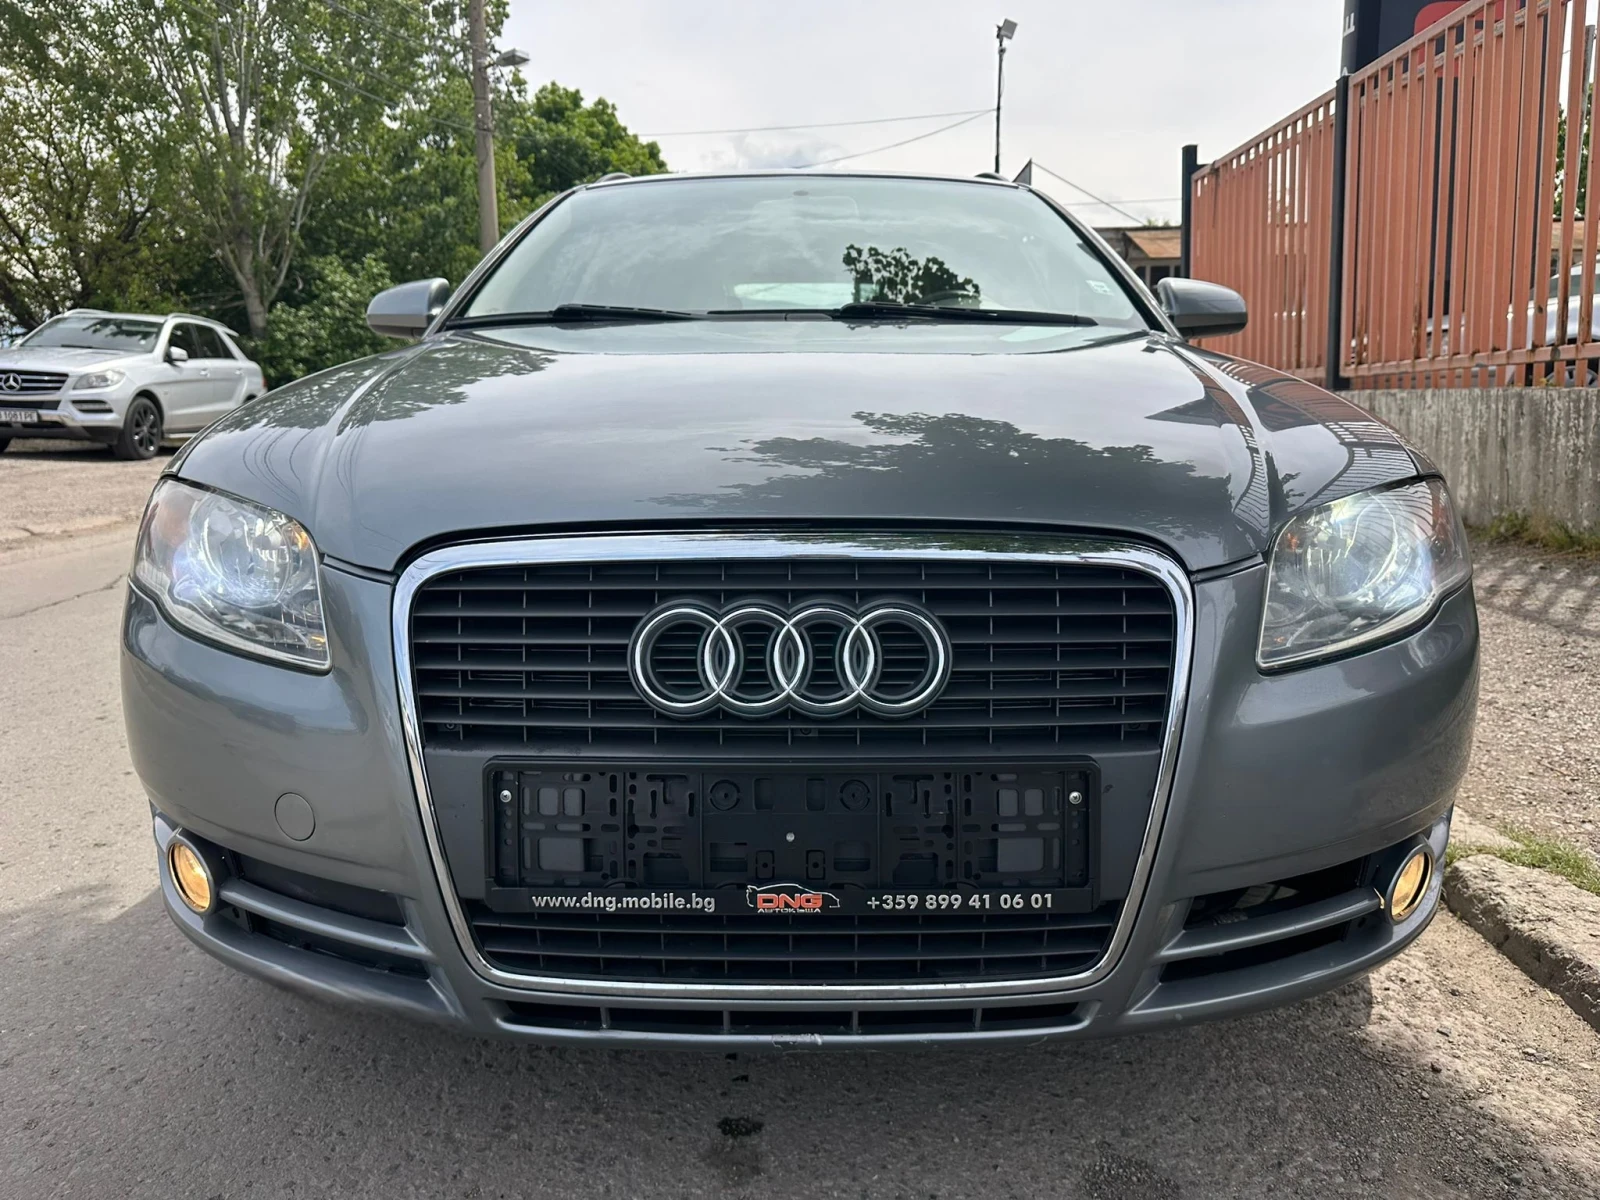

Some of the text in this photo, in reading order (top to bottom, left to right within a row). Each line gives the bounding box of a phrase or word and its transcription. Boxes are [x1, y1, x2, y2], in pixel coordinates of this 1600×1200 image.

[532, 892, 716, 912] www.dng.mobile.bg
[757, 894, 823, 909] DNG
[867, 893, 1053, 910] +359 899 41 06 01
